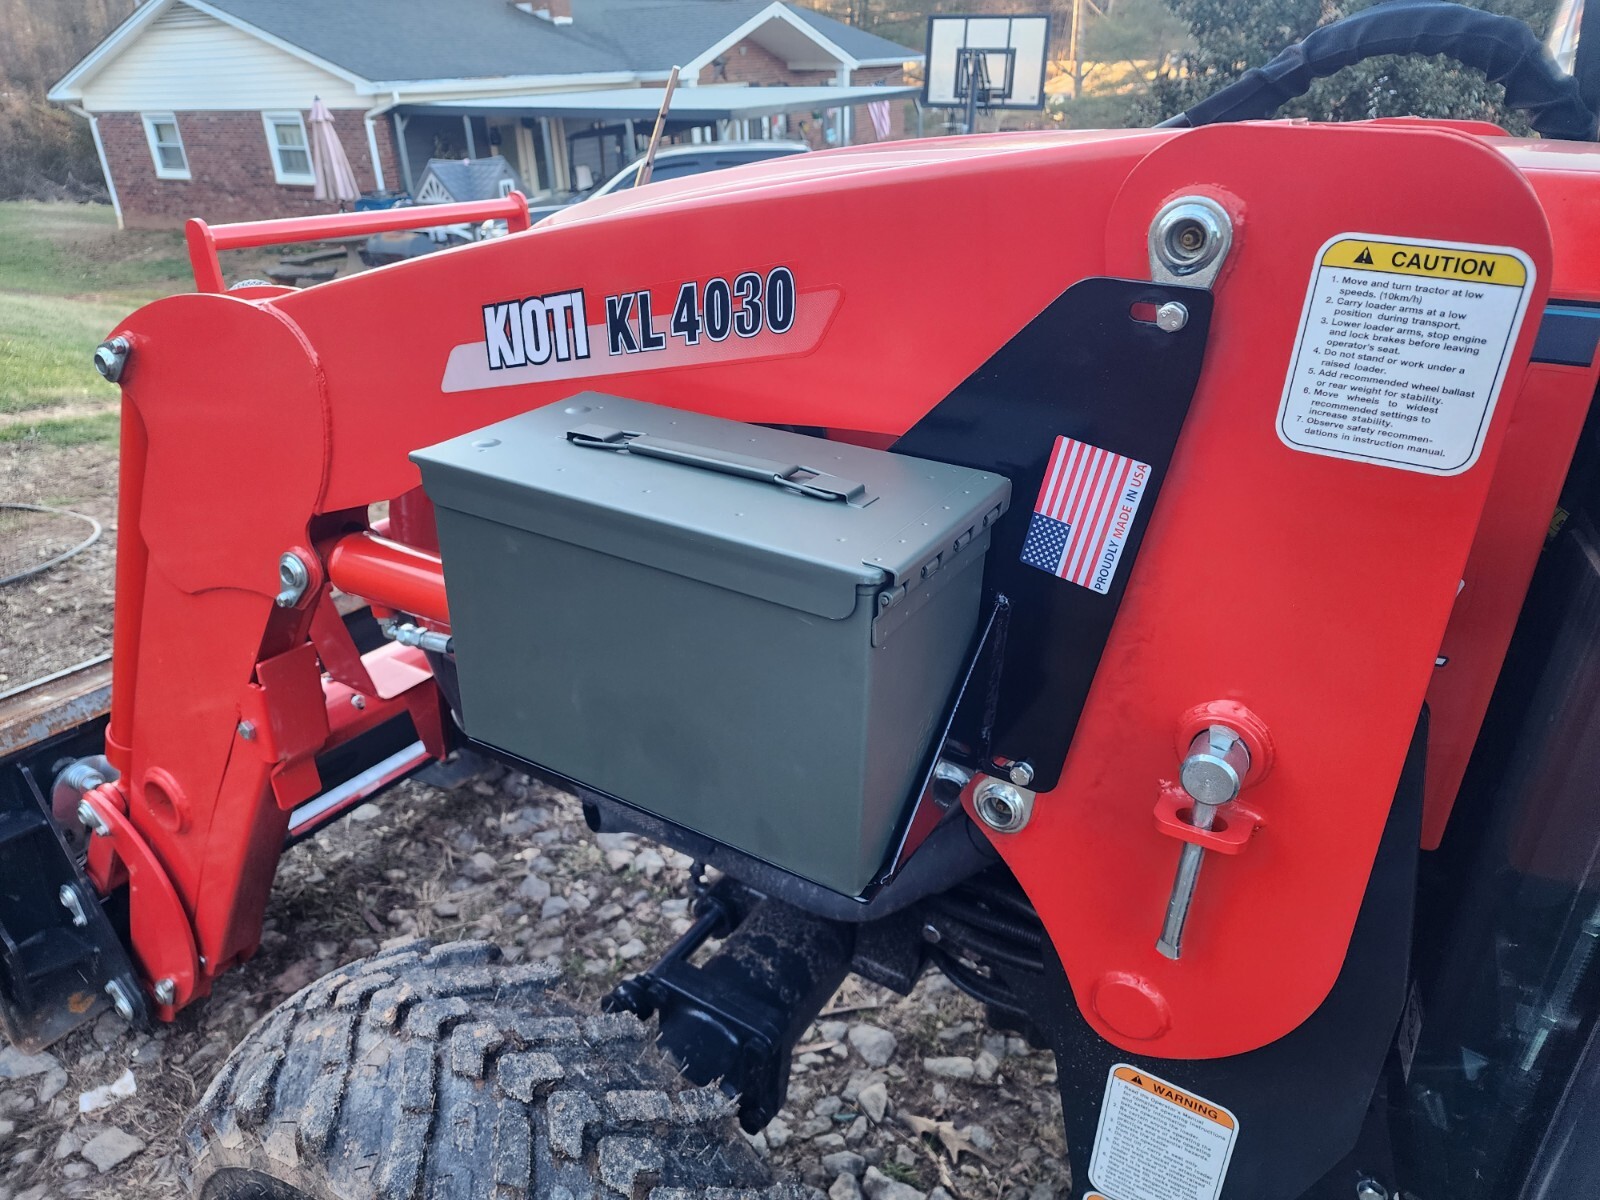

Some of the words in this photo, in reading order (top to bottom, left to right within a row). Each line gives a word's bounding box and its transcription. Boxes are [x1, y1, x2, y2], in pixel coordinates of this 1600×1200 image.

[1391, 251, 1496, 277] CAUTION
[1332, 275, 1339, 283] 1.
[1341, 276, 1368, 286] Move
[1370, 281, 1390, 289] and
[1392, 282, 1412, 291] turn
[1415, 285, 1450, 295] tractor
[1451, 289, 1463, 297] at
[1464, 289, 1484, 299] low
[1339, 289, 1376, 299] speeds.
[1379, 291, 1423, 305] (10km/h)
[482, 288, 590, 370] KIOTI
[605, 289, 666, 356] KL
[670, 265, 797, 345] 4030
[1325, 296, 1334, 304] 2.
[1337, 297, 1363, 309] Carry
[1365, 300, 1397, 311] loader
[1398, 306, 1424, 315] arms
[1448, 310, 1467, 320] low
[1333, 309, 1372, 319] position
[1377, 313, 1409, 325] during
[1412, 317, 1460, 330] transport.
[1320, 317, 1328, 325] 3.
[1331, 318, 1362, 328] Lower
[1363, 322, 1395, 333] loader
[1396, 328, 1424, 338] arms,
[1427, 331, 1450, 341] stop
[1452, 335, 1487, 345] engine
[1329, 329, 1347, 337] and
[1349, 330, 1370, 340] lock
[1372, 333, 1406, 345] brakes
[1408, 338, 1441, 350] before
[1443, 342, 1480, 356] leaving
[1313, 347, 1321, 355] 4.
[1324, 348, 1337, 356] Do
[1339, 351, 1355, 359] not
[1357, 354, 1385, 363] stand
[1400, 360, 1424, 369] work
[1427, 364, 1457, 373] under
[1326, 340, 1375, 351] operator's
[1377, 346, 1400, 355] seat.
[1321, 360, 1351, 369] raised
[1354, 363, 1386, 375] loader.
[1307, 367, 1316, 375] 5.
[1318, 369, 1338, 378] Add
[1339, 373, 1409, 388] recommended
[1411, 383, 1440, 393] wheel
[1441, 386, 1475, 398] ballast
[1328, 382, 1348, 390] rear
[1350, 385, 1382, 395] weight
[1384, 389, 1399, 398] for
[1400, 393, 1443, 405] stability.
[1303, 386, 1311, 395] 6.
[1313, 388, 1339, 399] Move
[1347, 394, 1380, 405] wheels
[1388, 400, 1398, 408] to
[1406, 403, 1439, 414] widest
[1311, 400, 1378, 416] recommended
[1380, 411, 1418, 422] settings
[1421, 416, 1431, 424] to
[1296, 415, 1304, 423] 7.
[1306, 417, 1344, 429] Observe
[1346, 425, 1376, 436] safety
[1377, 430, 1433, 443] recommen-
[1308, 407, 1348, 420] increase
[1351, 415, 1393, 428] stability.
[1304, 427, 1338, 439] dations
[1341, 432, 1350, 441] in
[1353, 435, 1404, 450] instruction
[1406, 445, 1445, 457] manual.
[1131, 464, 1148, 488] USA
[1125, 489, 1138, 502] IN
[1113, 505, 1132, 539] MADE
[1094, 540, 1119, 591] PROUDLY
[1153, 1083, 1218, 1120] WARNING
